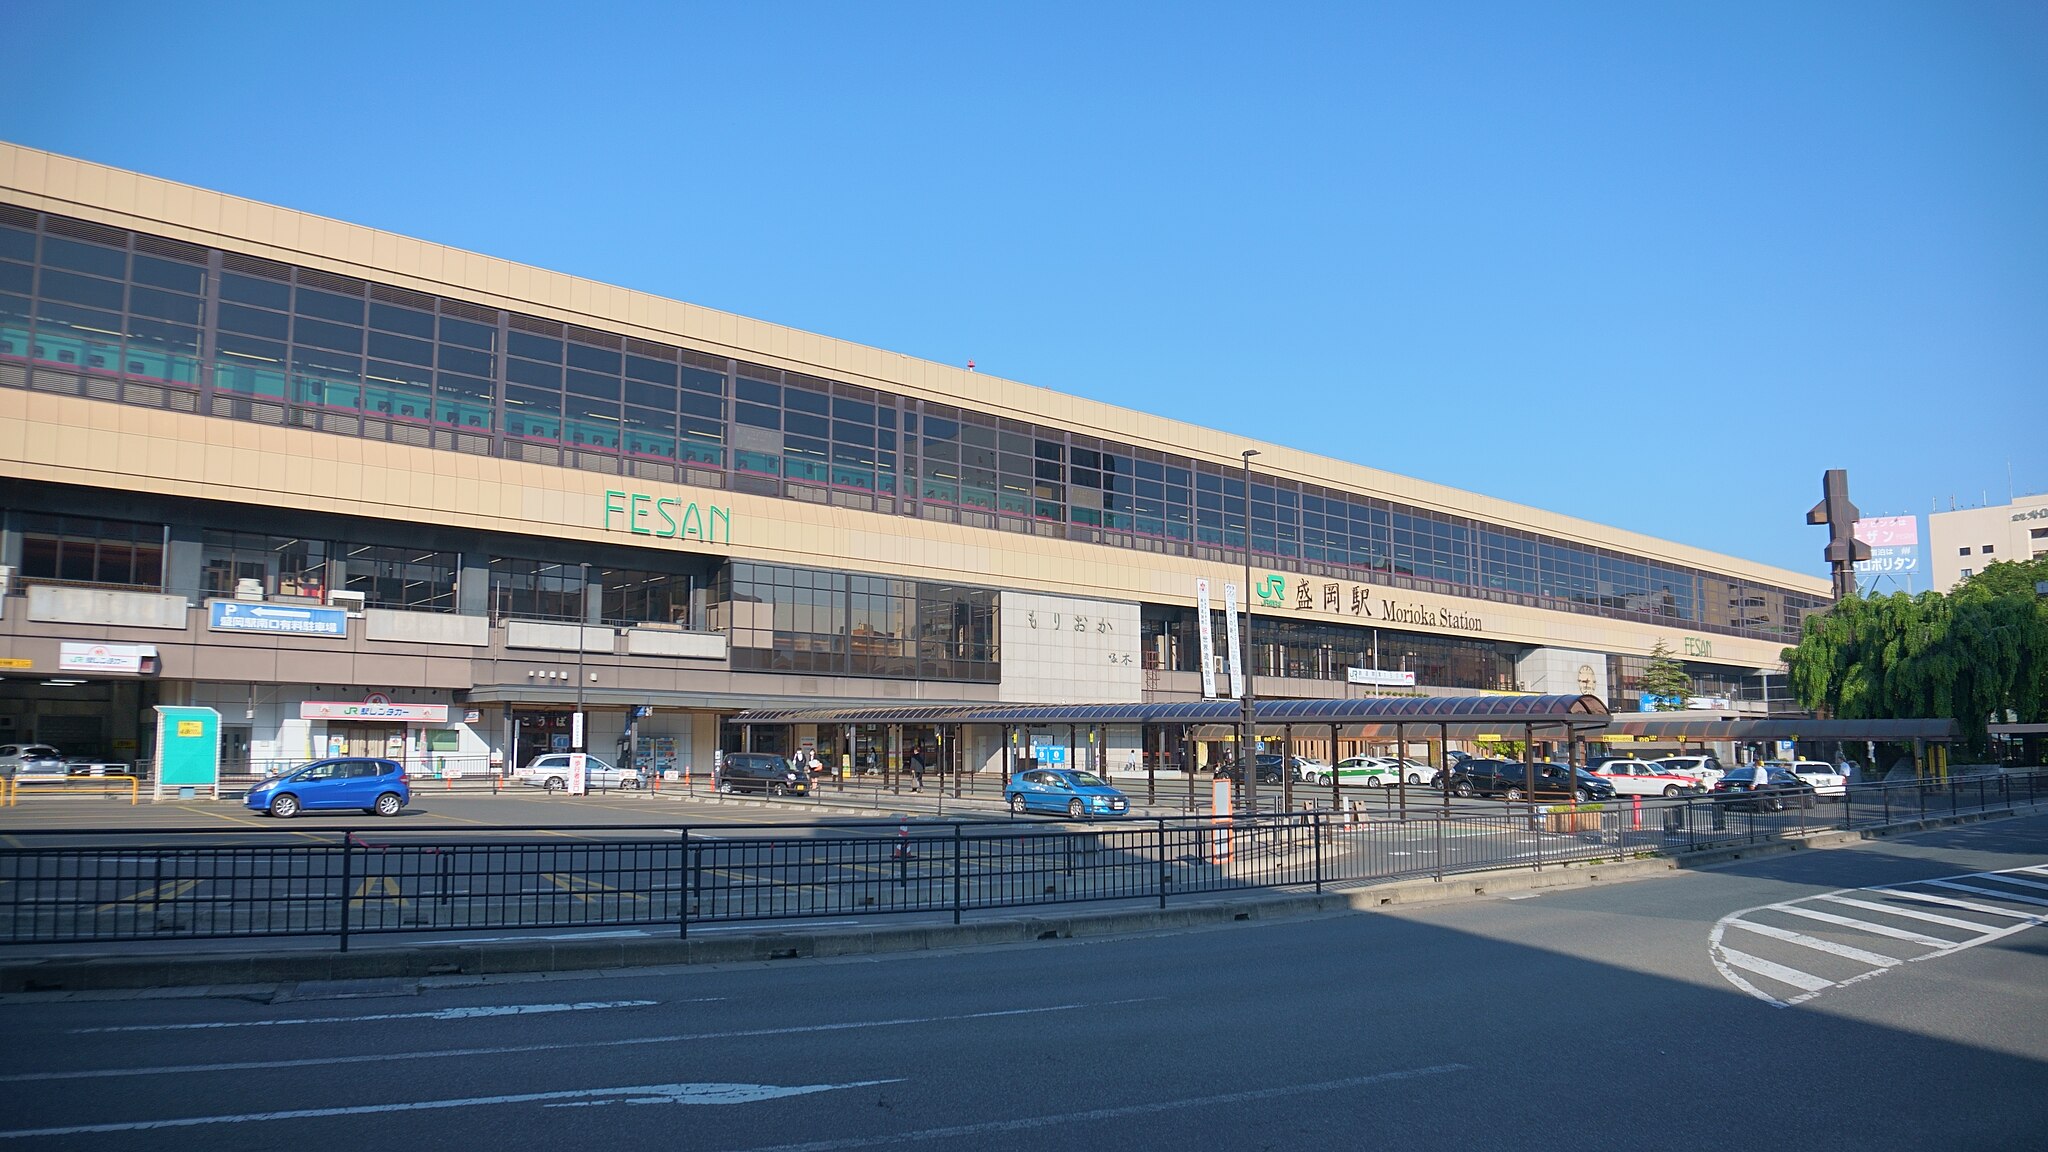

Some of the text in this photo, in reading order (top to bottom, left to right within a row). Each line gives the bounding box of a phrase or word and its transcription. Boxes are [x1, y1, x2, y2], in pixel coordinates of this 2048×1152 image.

[605, 489, 731, 545] FESAN
[1256, 574, 1285, 600] JR
[224, 604, 238, 616] P
[1296, 578, 1483, 632] 盛岡駅 Morioka Station
[219, 616, 338, 633] 盛岡駅南口有料駐車場
[1028, 610, 1113, 634] もりおか
[1684, 636, 1713, 658] FESAN
[344, 707, 409, 716] JR 駅レンタカー
